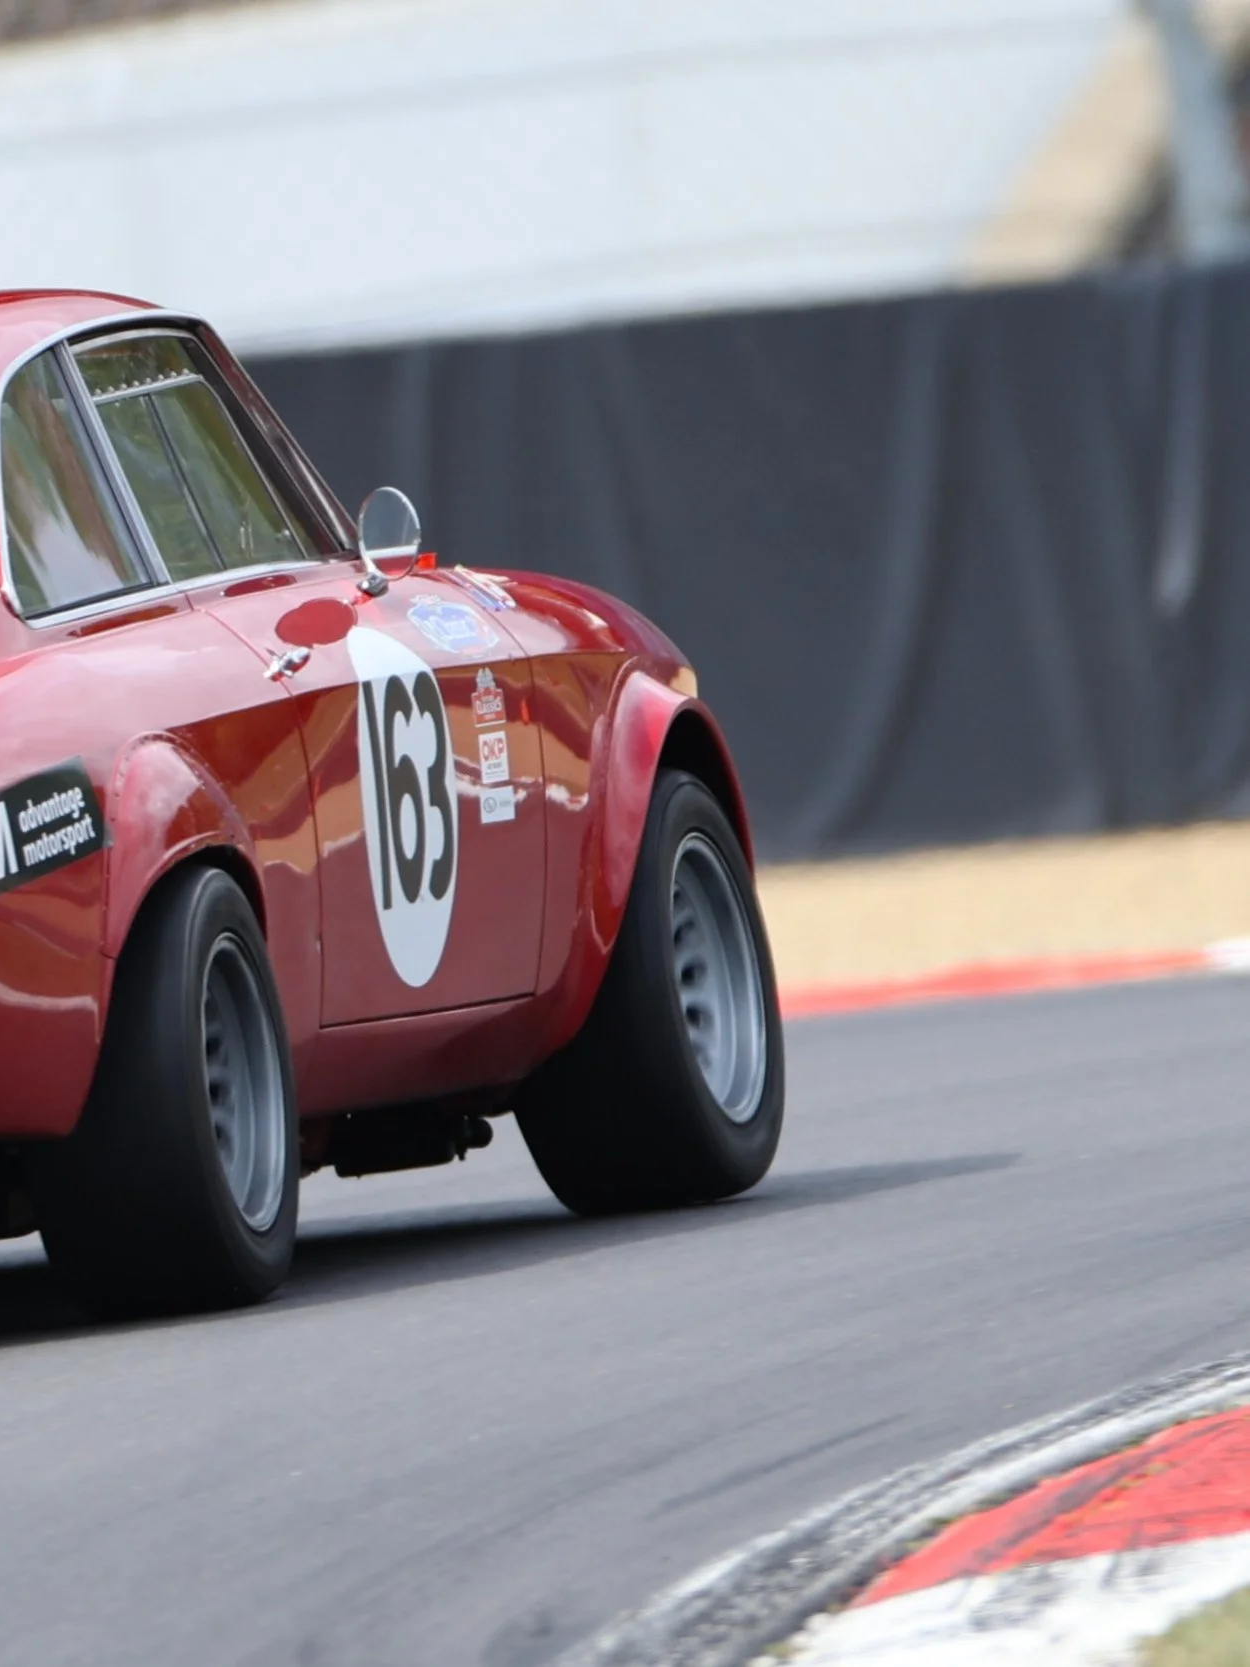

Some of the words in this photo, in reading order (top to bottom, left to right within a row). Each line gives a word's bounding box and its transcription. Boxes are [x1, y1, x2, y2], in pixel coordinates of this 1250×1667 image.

[482, 738, 504, 762] OKP
[18, 786, 86, 833] advantage
[361, 671, 456, 911] 163
[22, 813, 96, 867] motorsport
